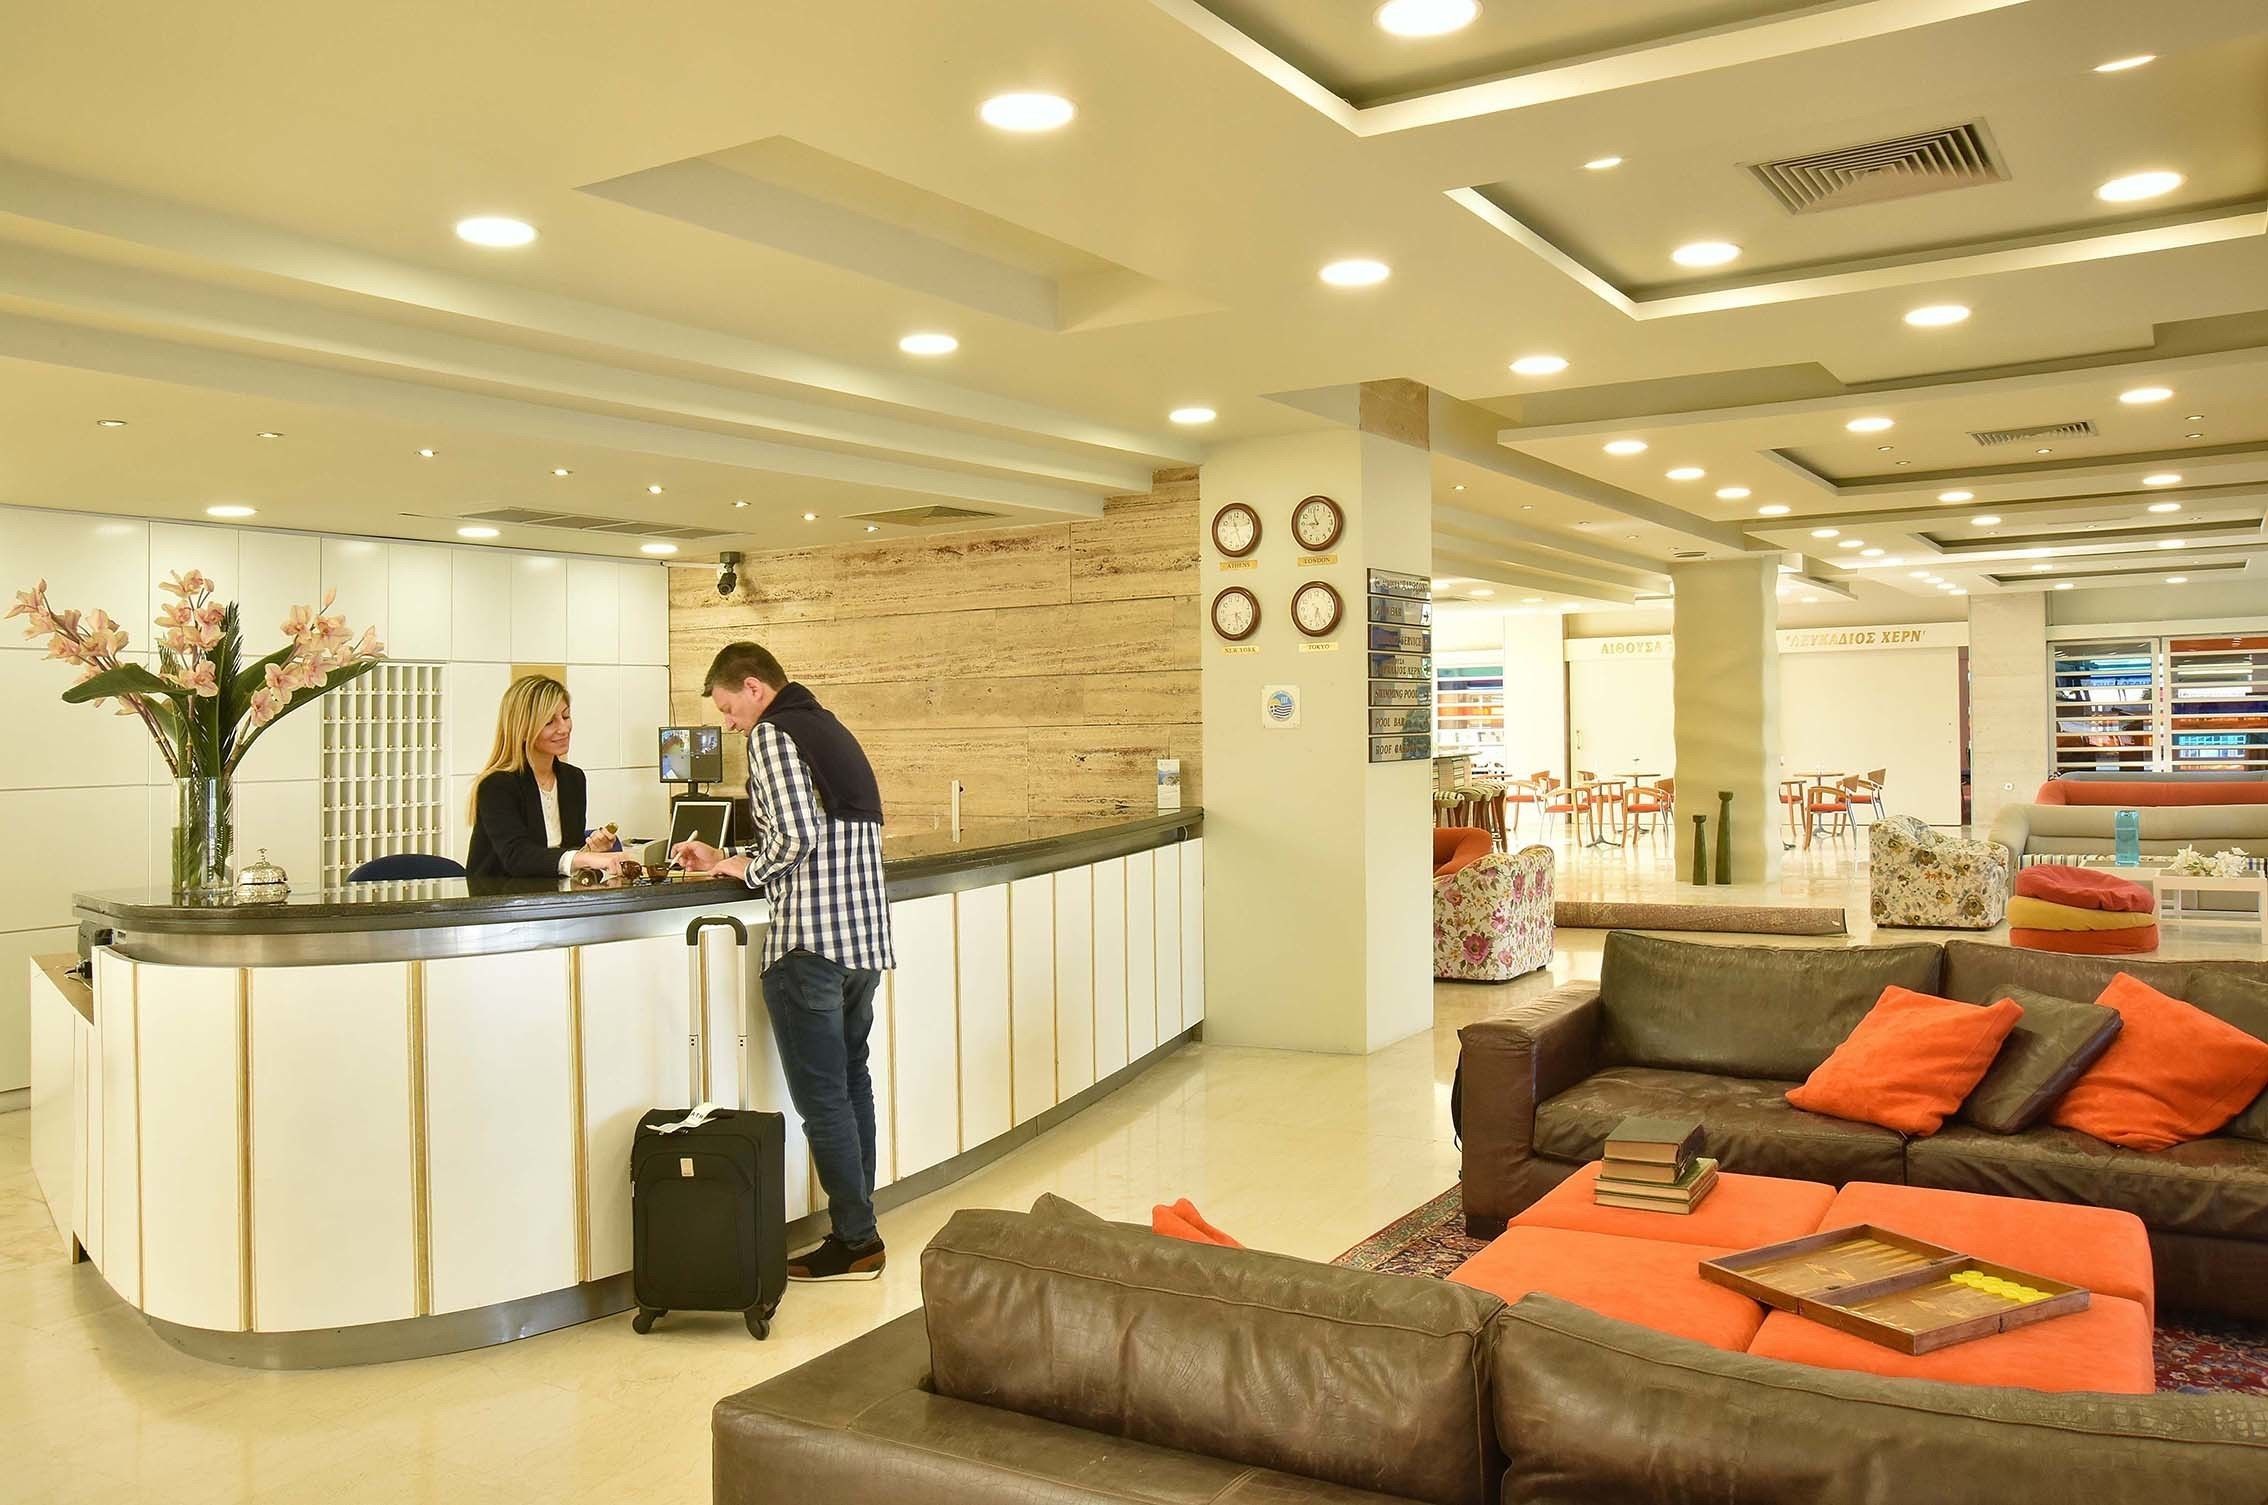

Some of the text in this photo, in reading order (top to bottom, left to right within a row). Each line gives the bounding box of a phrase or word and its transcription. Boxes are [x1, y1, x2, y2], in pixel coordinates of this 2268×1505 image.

[1226, 562, 1250, 570] ATHENS
[1303, 557, 1330, 565] LONDON
[1400, 636, 1422, 647] SERVICE
[1600, 640, 1662, 655] ΑΙΘΟΥΣΑ
[1375, 716, 1404, 728] POOL BAR
[1375, 744, 1392, 755] ROOF
